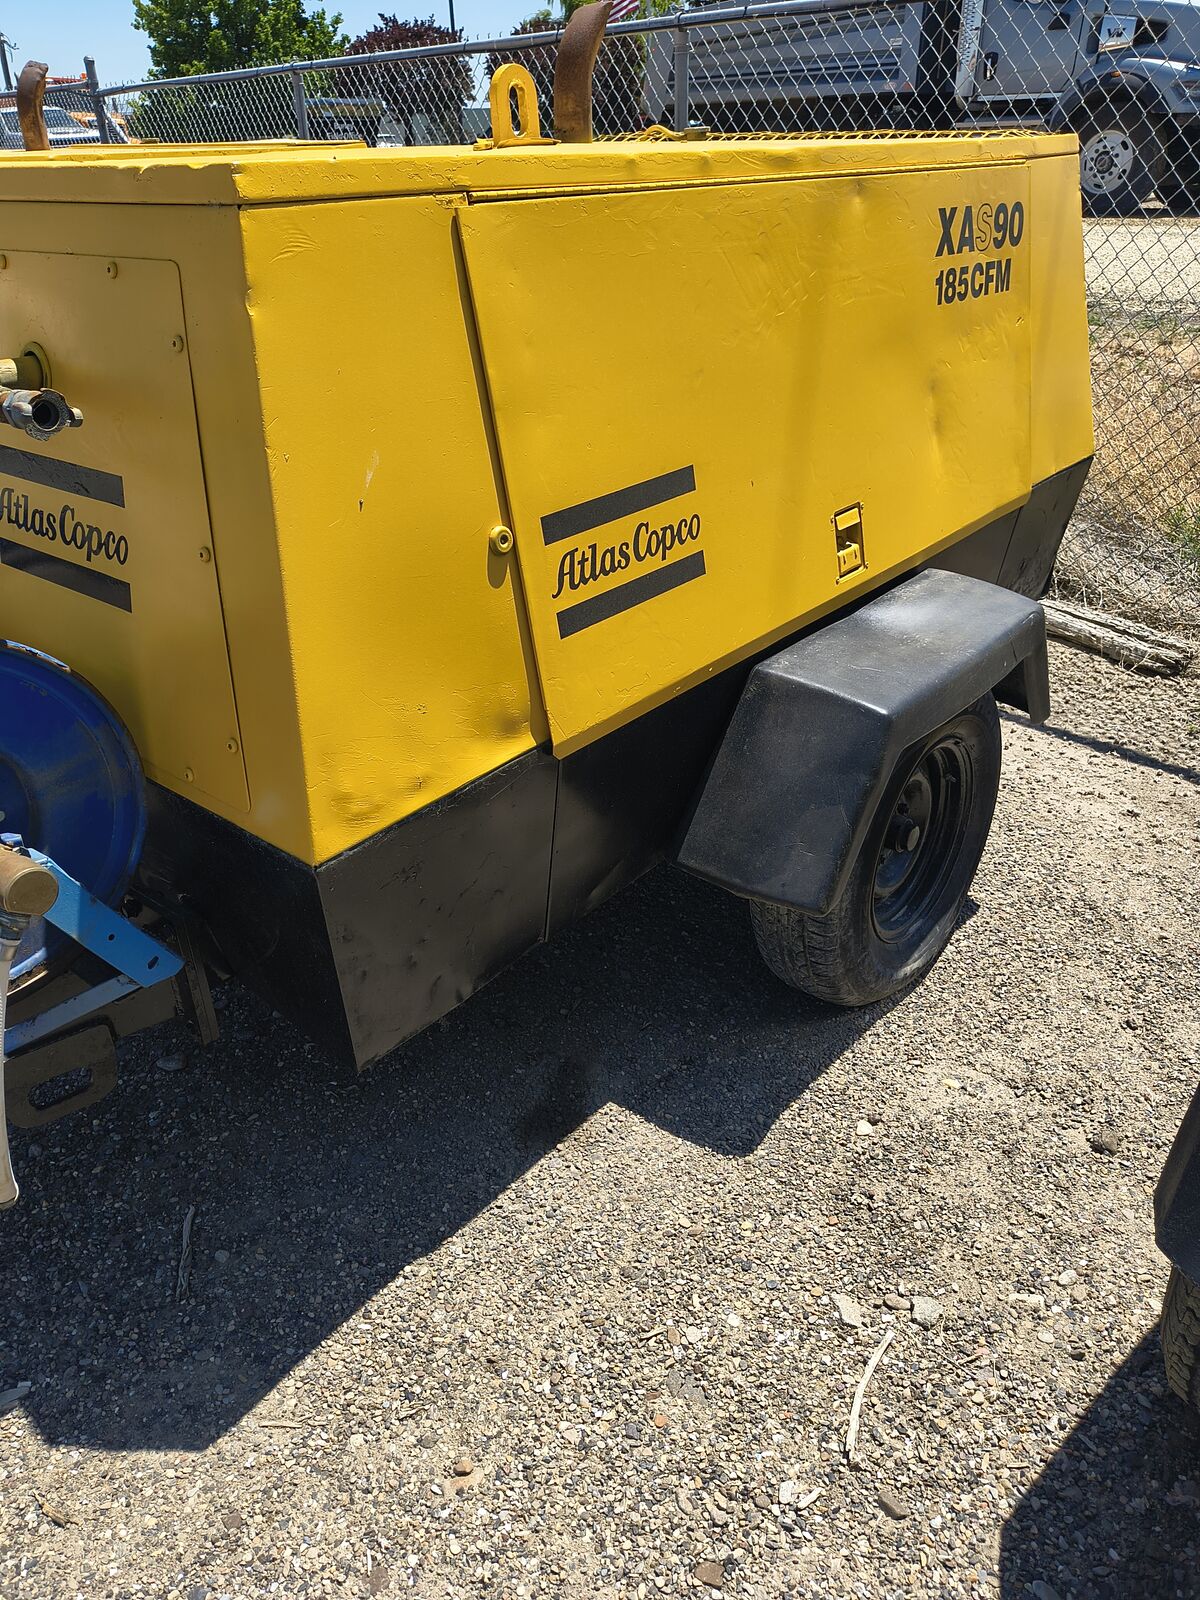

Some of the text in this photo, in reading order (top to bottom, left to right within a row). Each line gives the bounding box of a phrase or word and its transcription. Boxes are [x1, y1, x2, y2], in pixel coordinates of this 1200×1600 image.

[935, 201, 1024, 257] XAS90
[935, 258, 1012, 305] 185CFM
[0, 487, 129, 565] Atlas Copco
[551, 513, 701, 599] Atlas Copco
